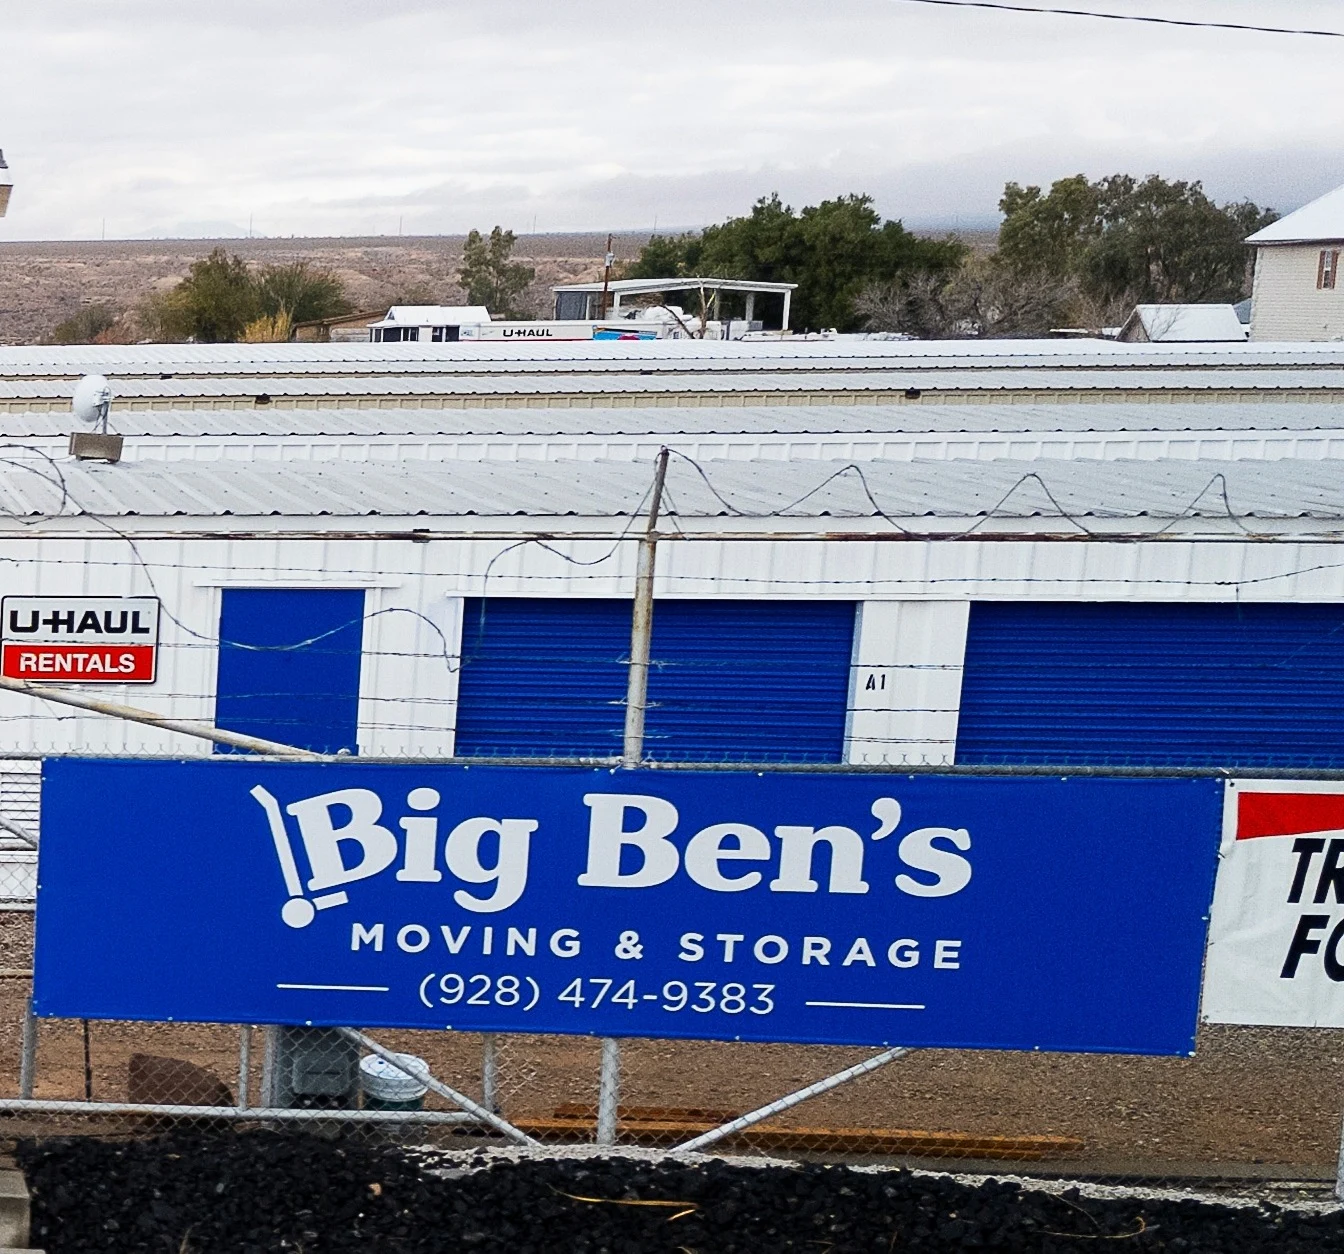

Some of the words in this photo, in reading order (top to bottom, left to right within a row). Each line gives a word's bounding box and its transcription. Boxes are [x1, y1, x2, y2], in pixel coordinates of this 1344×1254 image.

[502, 328, 553, 338] U-HAUL
[9, 610, 151, 634] U-HAUL
[19, 653, 135, 673] RENTALS
[865, 673, 886, 691] A1
[286, 787, 539, 913] Big
[577, 793, 972, 898] Ben's
[351, 922, 581, 958] MOVING
[614, 930, 644, 960] &
[678, 932, 962, 971] STORAGE
[419, 973, 540, 1011] (928)
[557, 977, 775, 1015] 474-9383
